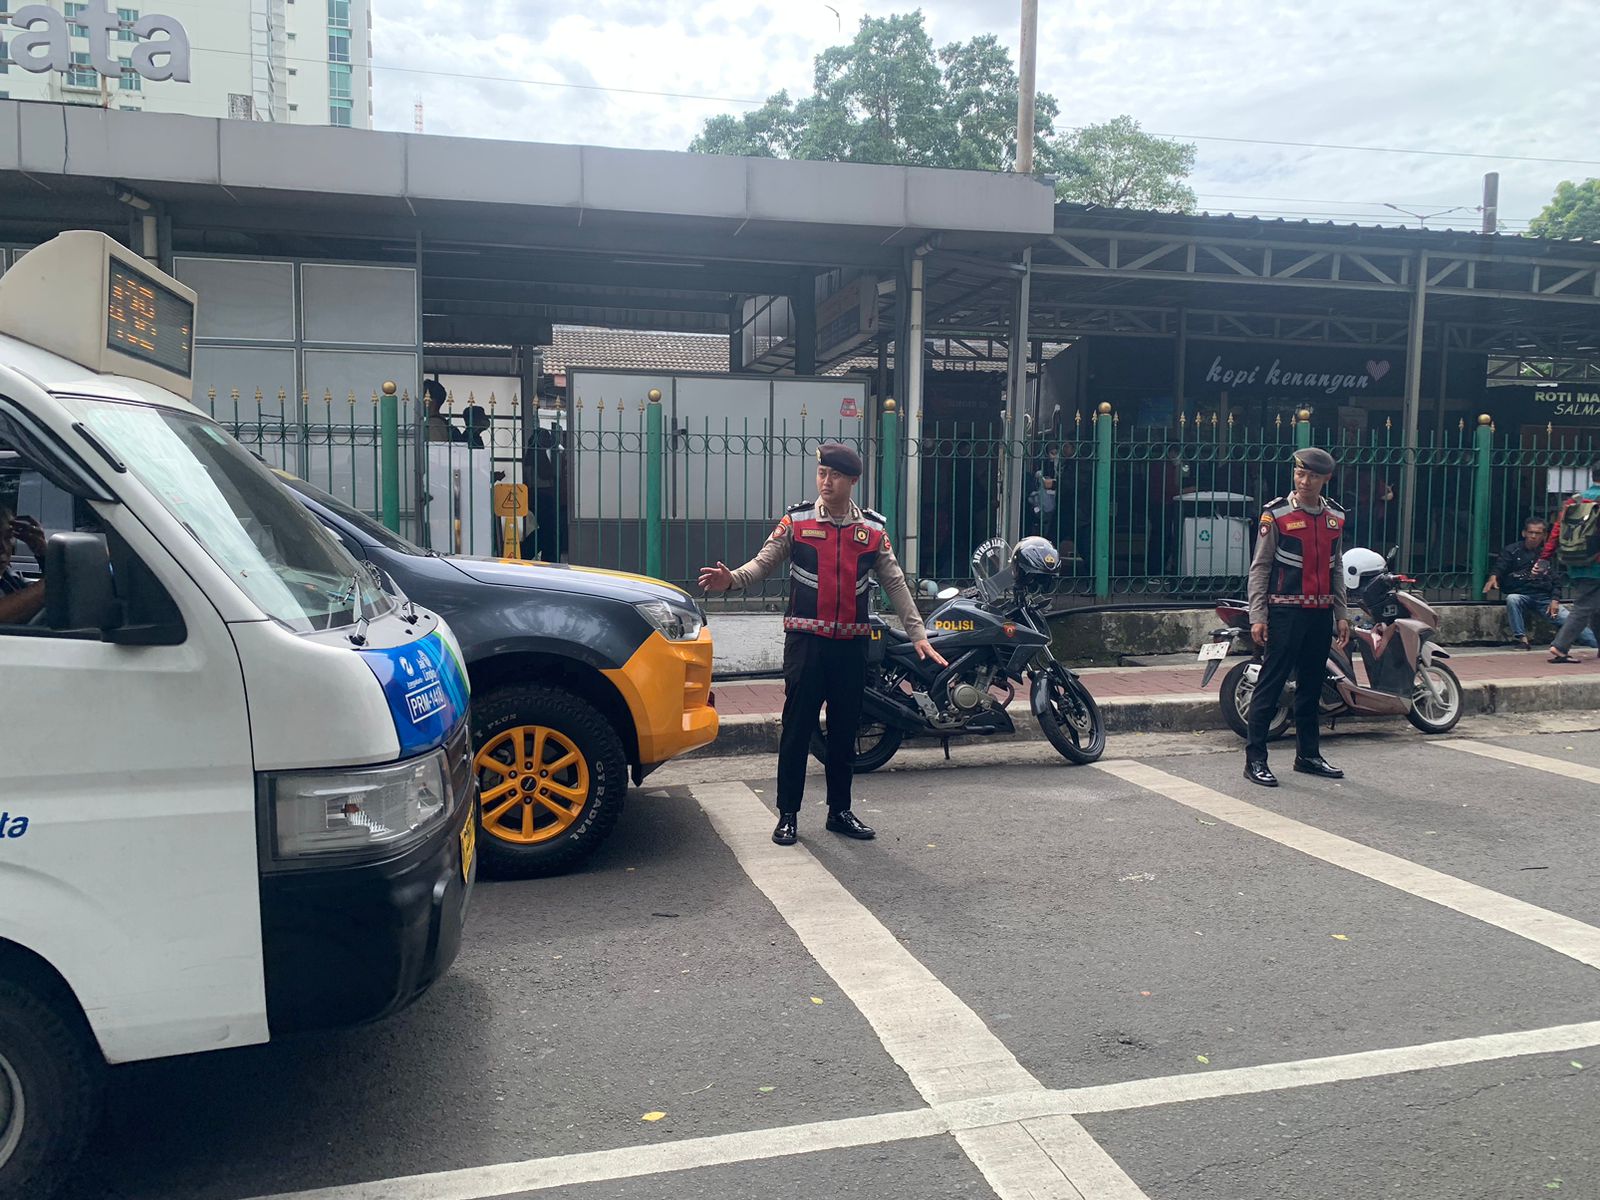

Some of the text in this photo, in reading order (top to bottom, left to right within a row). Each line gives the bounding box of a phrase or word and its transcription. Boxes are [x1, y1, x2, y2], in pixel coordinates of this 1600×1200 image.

[0, 0, 191, 83] ata
[1206, 355, 1370, 394] kopi kenangan
[1534, 391, 1572, 402] ROTI
[934, 620, 974, 632] POLISI
[569, 760, 606, 841] GT RADIAL
[0, 812, 29, 838] ta
